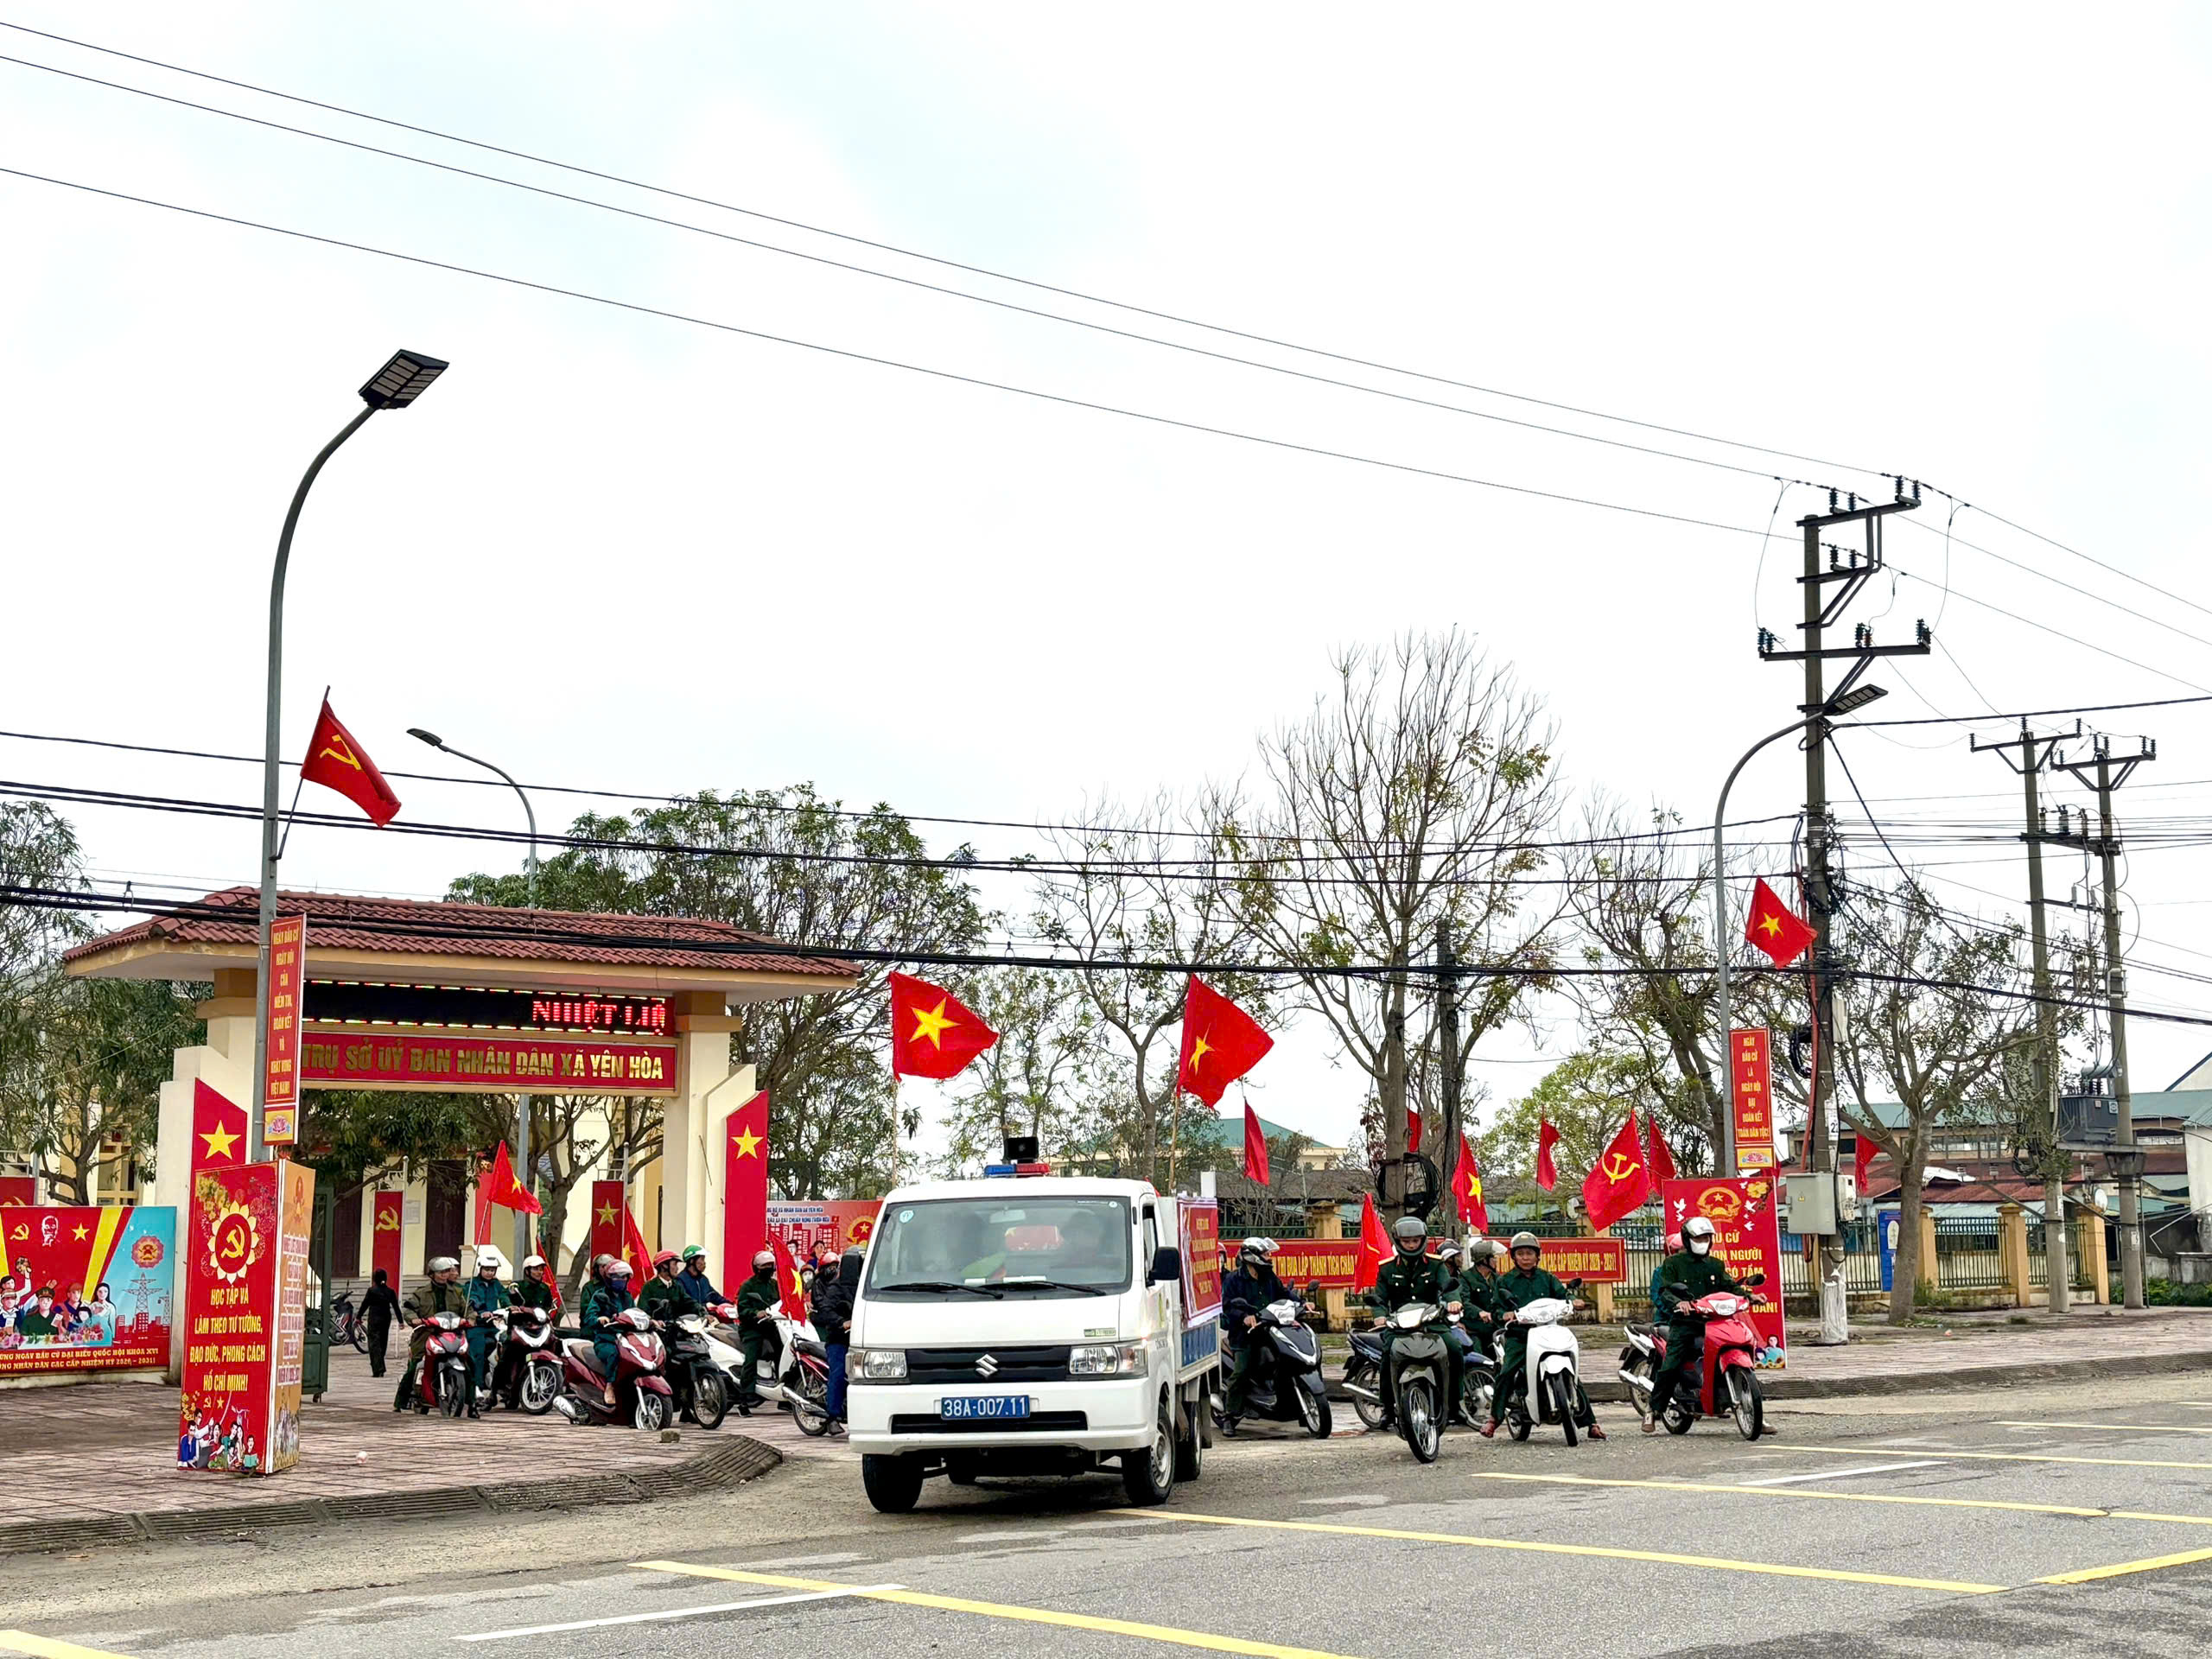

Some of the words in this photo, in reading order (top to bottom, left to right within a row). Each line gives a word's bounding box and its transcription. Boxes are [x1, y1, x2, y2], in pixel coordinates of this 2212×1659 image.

[532, 1001, 617, 1029] NHIỆT
[302, 1044, 339, 1075] TRỤ
[346, 1037, 373, 1071] SỞ
[410, 1047, 450, 1072] BAN
[457, 1045, 510, 1075] NHÂN
[516, 1047, 554, 1076] DÂN
[561, 1049, 585, 1077] XÃ
[590, 1049, 624, 1078] YÊN
[629, 1051, 663, 1079] HÒA
[1726, 1229, 1740, 1243] CỬ
[1730, 1247, 1763, 1261] NGƯỜI
[210, 1288, 225, 1308] HỌC
[226, 1285, 238, 1308] TẬP
[240, 1284, 249, 1304] VÀ
[194, 1314, 209, 1334] LÀM
[211, 1317, 226, 1334] THEO
[228, 1315, 238, 1334] TƯ
[238, 1311, 263, 1334] TƯỞNG,
[189, 1345, 203, 1366] ĐẠO
[205, 1343, 220, 1364] ĐỨC,
[222, 1345, 245, 1363] PHONG
[246, 1342, 265, 1363] CÁCH
[203, 1369, 213, 1391] HỒ
[213, 1371, 226, 1391] CHÍ
[226, 1374, 249, 1391] MINH!
[944, 1396, 1027, 1416] 38A-007.11
